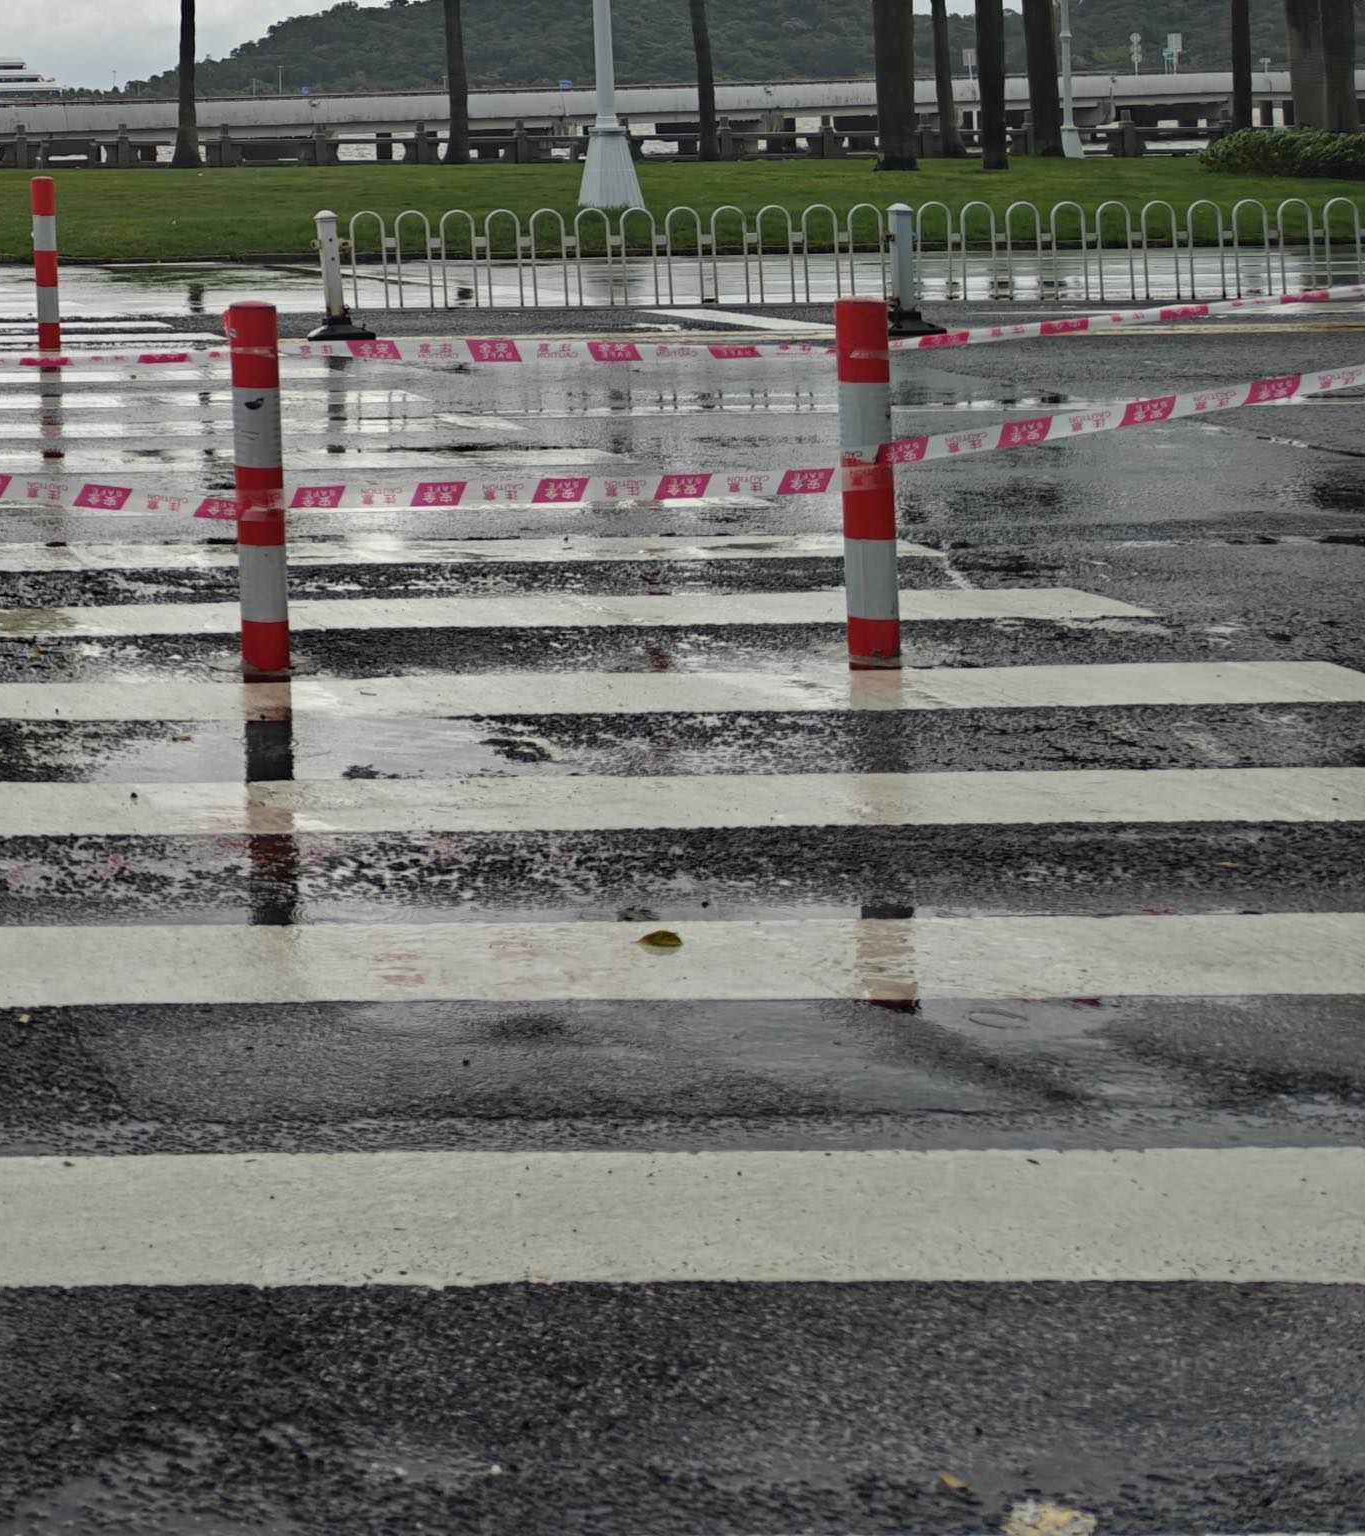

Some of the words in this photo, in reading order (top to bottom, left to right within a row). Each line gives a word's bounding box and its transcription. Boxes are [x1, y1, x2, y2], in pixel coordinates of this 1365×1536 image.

[1068, 411, 1111, 424] CAUTION
[1071, 418, 1105, 432] 注意
[944, 431, 988, 444] CAUTION
[948, 438, 982, 453] 注意
[727, 474, 769, 485] CAUTION
[668, 481, 699, 496] 安全
[728, 481, 763, 493] 注意
